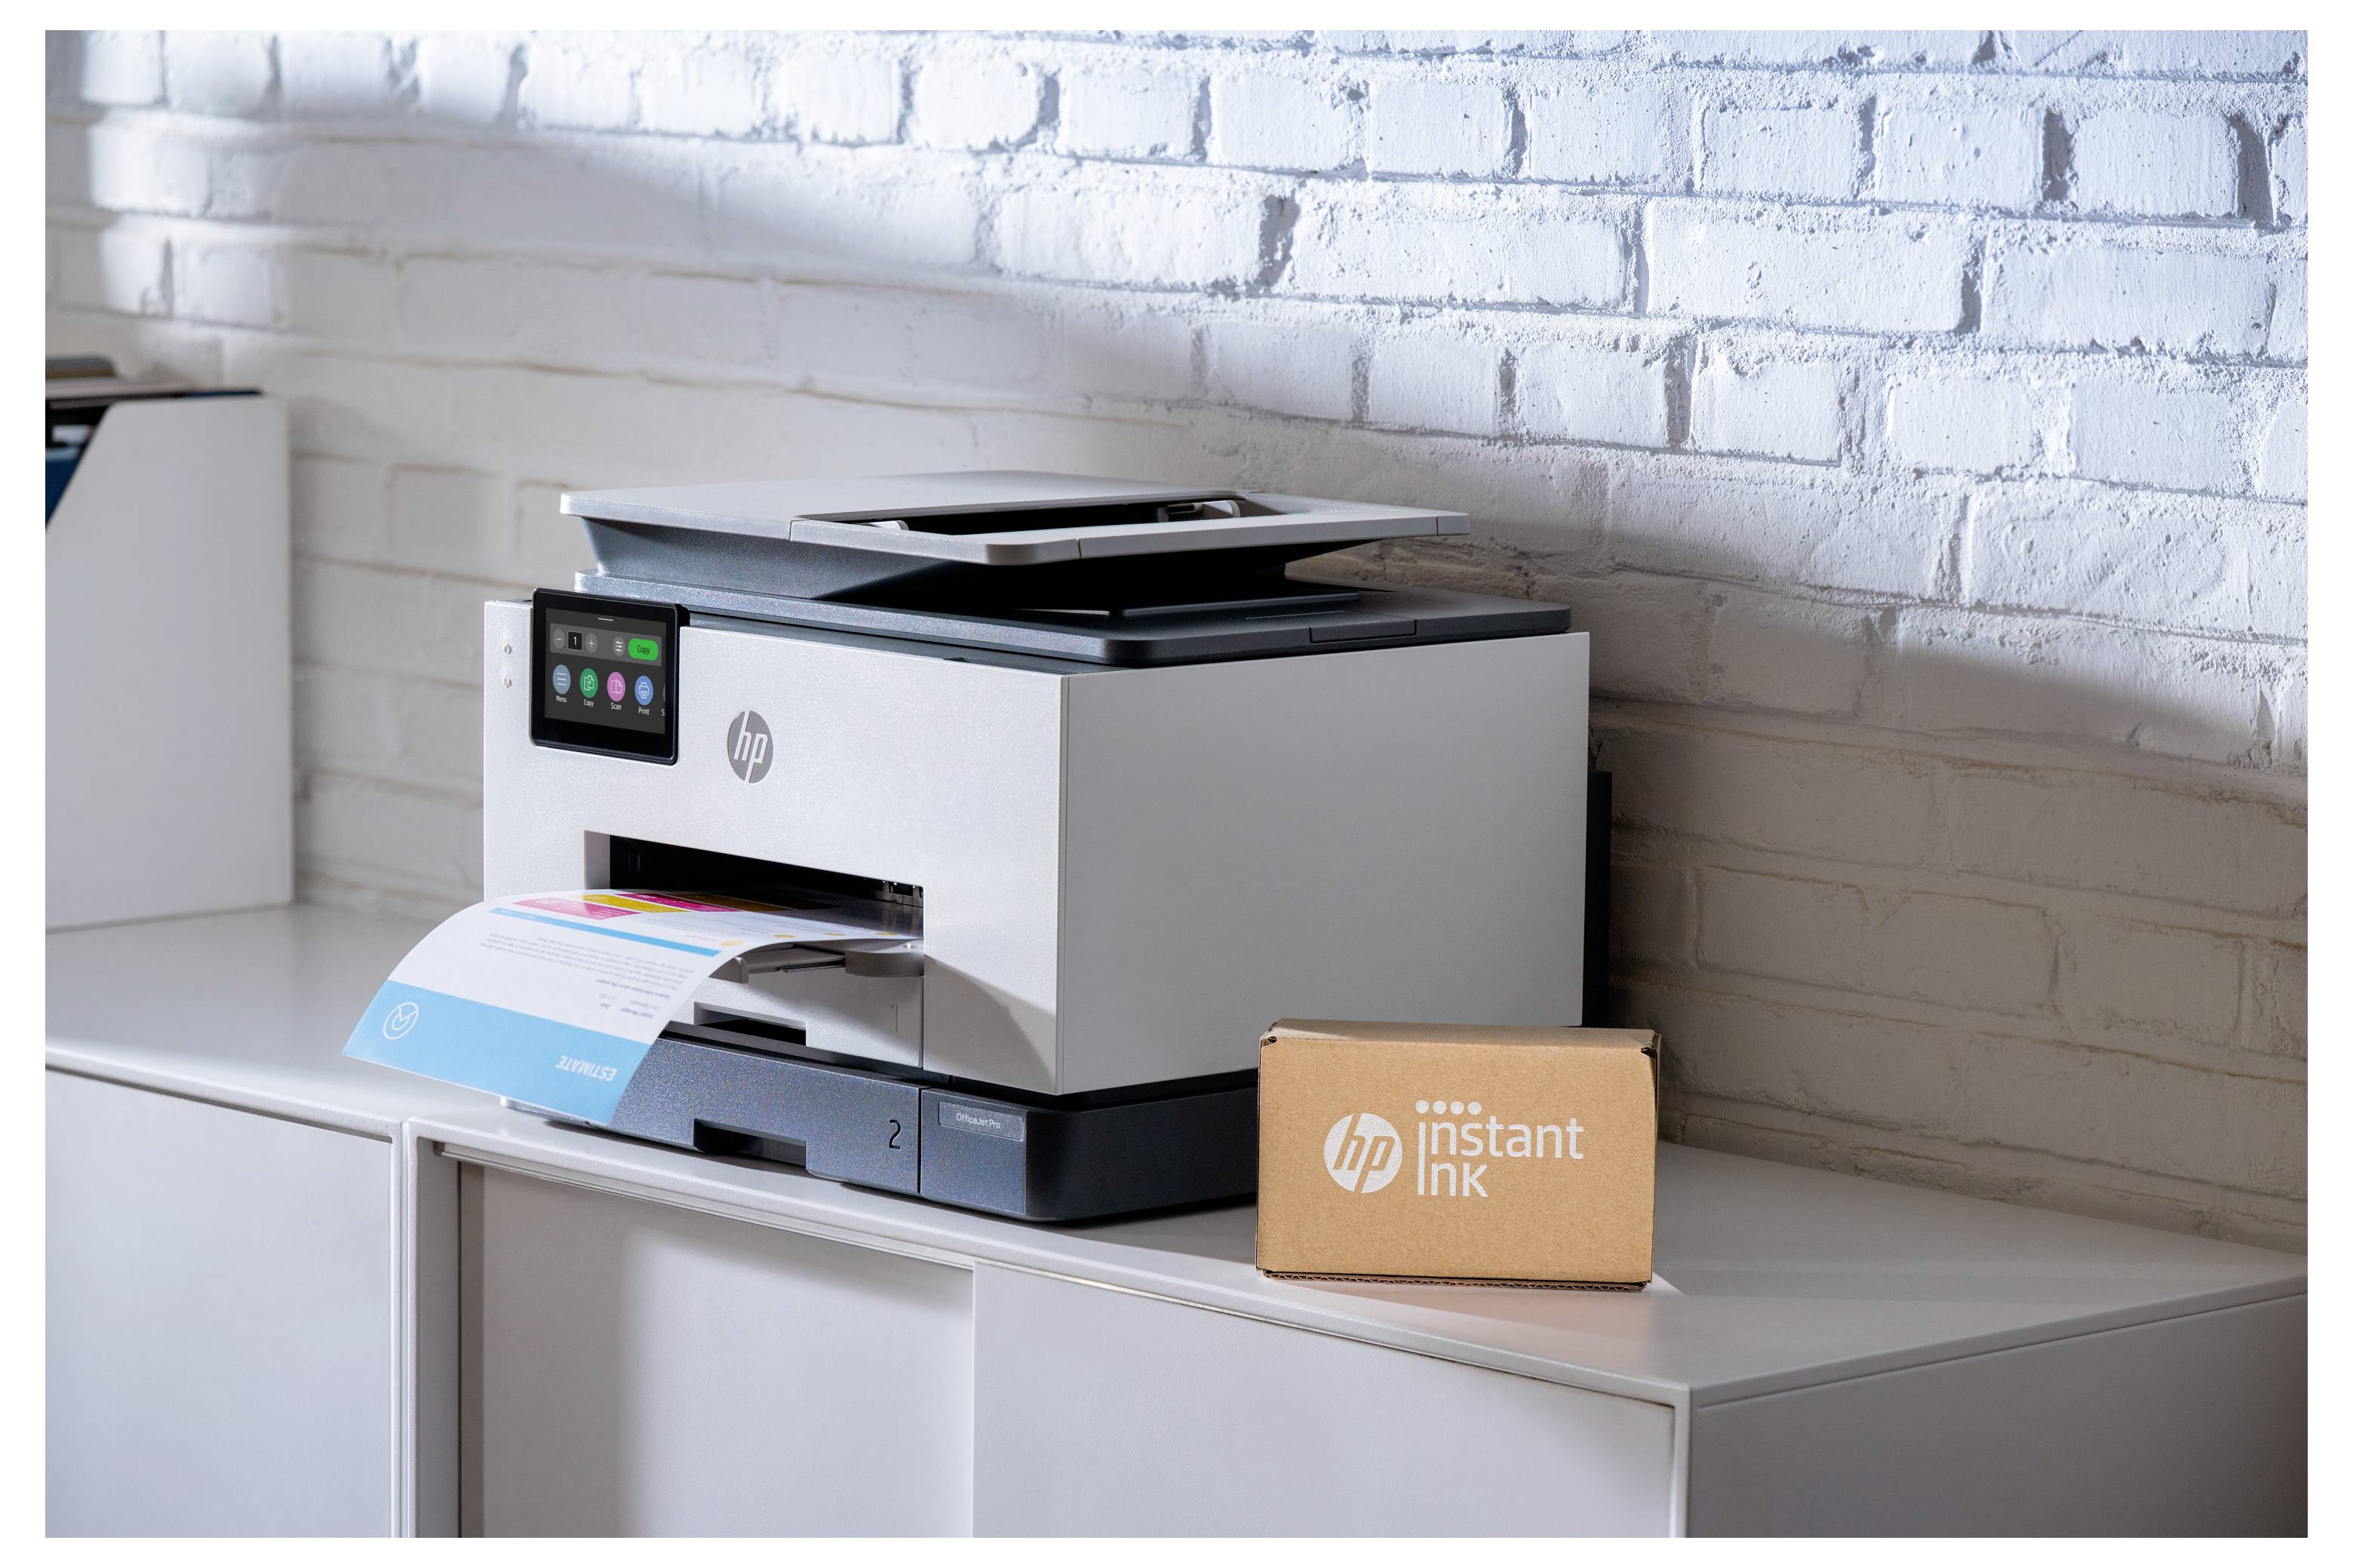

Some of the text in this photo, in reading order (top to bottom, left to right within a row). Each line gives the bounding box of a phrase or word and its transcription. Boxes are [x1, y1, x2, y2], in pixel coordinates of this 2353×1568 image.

[573, 636, 577, 646] 1
[637, 644, 650, 655] Copy
[555, 695, 567, 704] Menu
[583, 699, 594, 707] Copy
[610, 702, 622, 710] Scan
[637, 707, 650, 716] Print
[732, 710, 769, 784] hp
[556, 1055, 618, 1082] ESTIMATE
[956, 1112, 1001, 1129] OfficeJet Pro
[889, 1119, 901, 1150] 2
[1416, 1100, 1584, 1159] instant
[1329, 1112, 1398, 1193] hp
